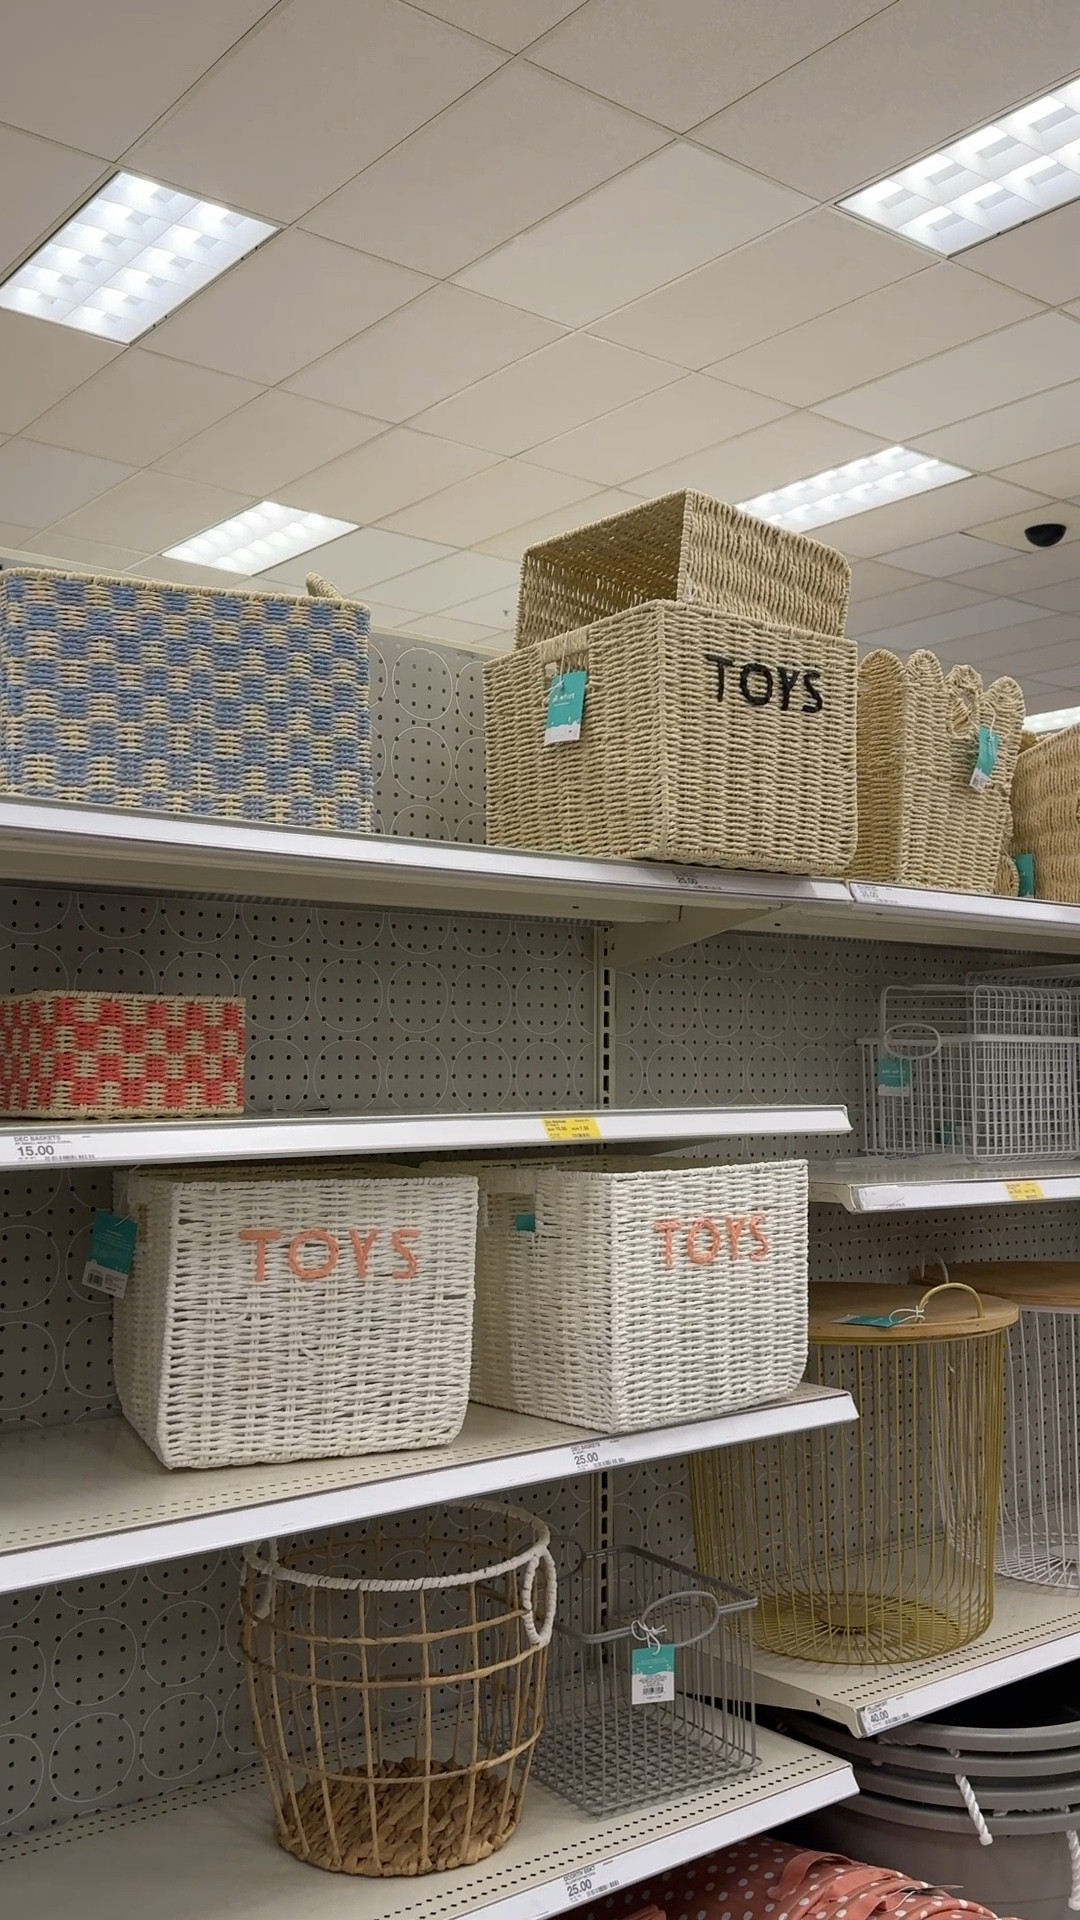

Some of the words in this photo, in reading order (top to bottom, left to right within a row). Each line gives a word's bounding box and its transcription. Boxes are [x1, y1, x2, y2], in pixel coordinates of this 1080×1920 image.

[705, 654, 822, 713] TOYS
[17, 1145, 54, 1156] 15.00
[655, 1213, 770, 1269] TOYS
[239, 1228, 420, 1282] TOYS
[574, 1451, 599, 1465] 25.00
[870, 1709, 889, 1722] 40.00
[567, 1878, 592, 1897] 25.00
